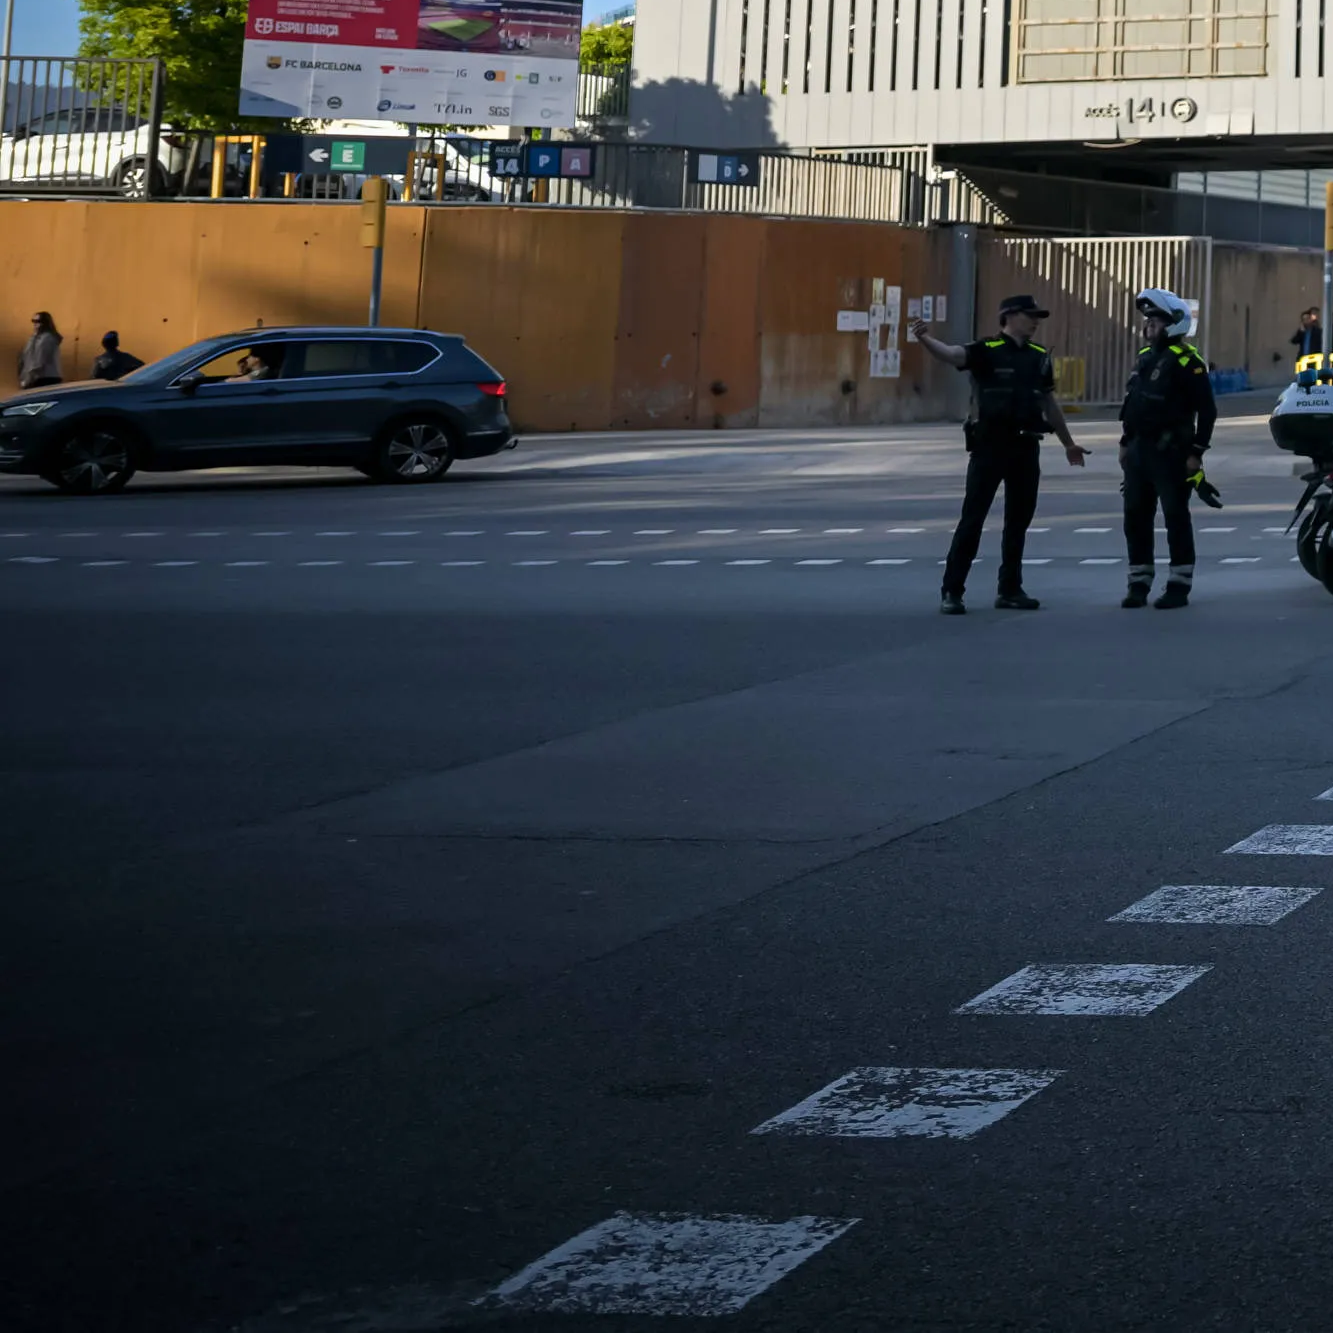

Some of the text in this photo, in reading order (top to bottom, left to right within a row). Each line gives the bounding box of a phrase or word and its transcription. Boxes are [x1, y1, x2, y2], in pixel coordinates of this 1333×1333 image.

[275, 20, 339, 38] ESPAI BARÇA
[285, 59, 362, 72] FC BARCELONA
[488, 106, 509, 117] SGS
[1127, 97, 1156, 124] 14
[496, 158, 519, 175] 14
[538, 154, 550, 167] P
